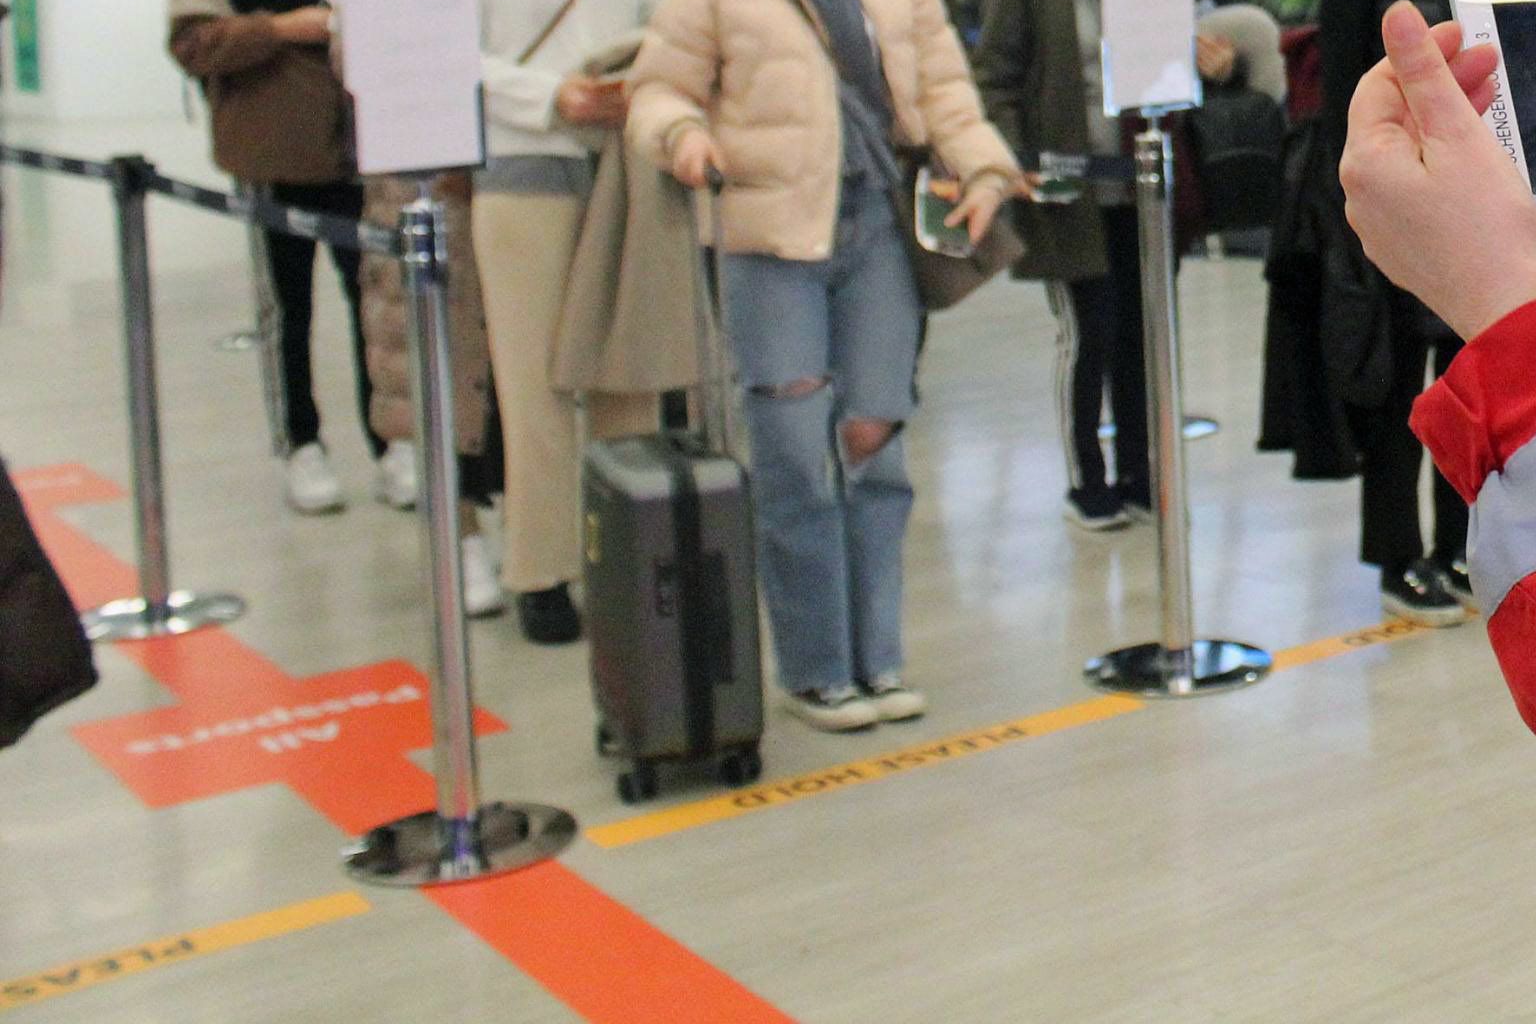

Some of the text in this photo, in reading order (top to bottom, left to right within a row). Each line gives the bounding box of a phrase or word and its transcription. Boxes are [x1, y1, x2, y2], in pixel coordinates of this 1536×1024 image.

[1475, 31, 1490, 40] 3
[125, 685, 422, 755] Passports
[732, 768, 864, 810] HOLD
[2, 939, 195, 996] PLEAS
